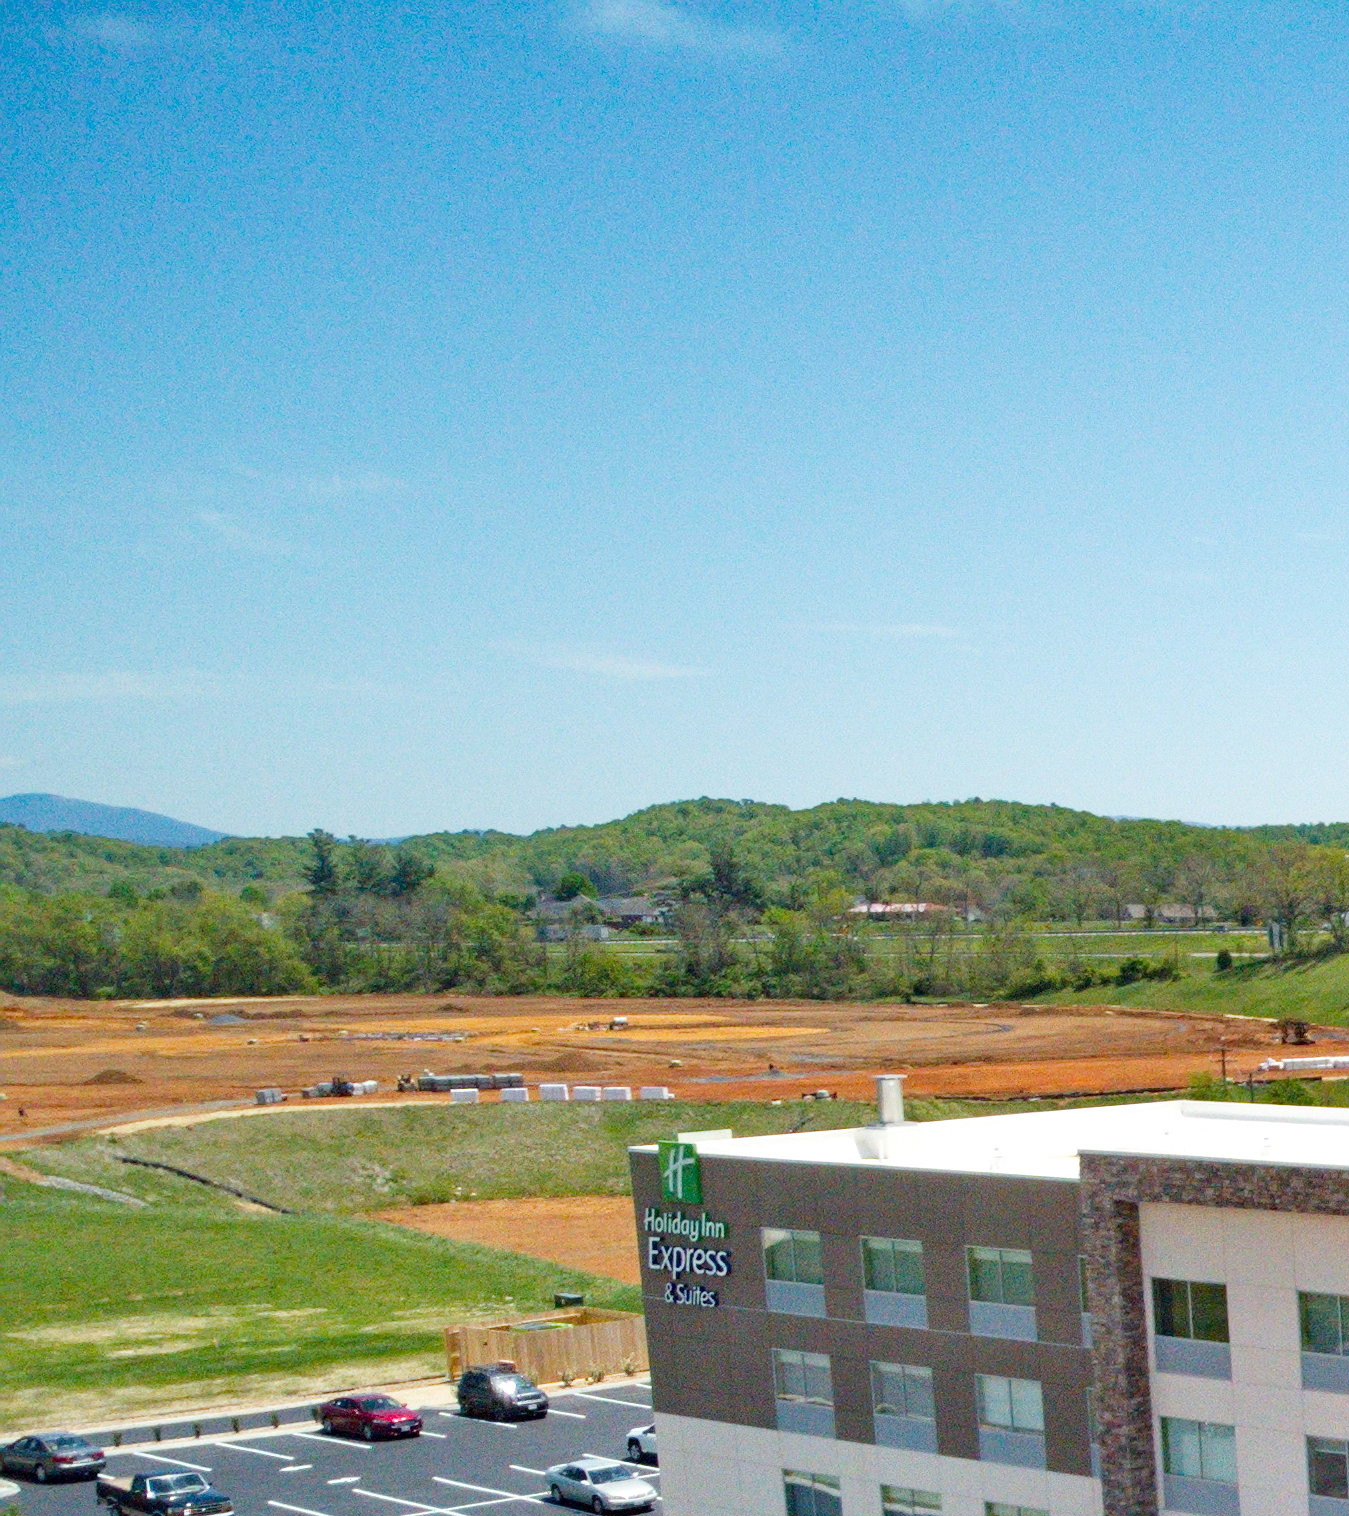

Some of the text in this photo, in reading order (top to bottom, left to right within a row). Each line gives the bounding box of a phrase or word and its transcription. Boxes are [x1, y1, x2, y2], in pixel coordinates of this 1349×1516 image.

[664, 1145, 695, 1199] H
[644, 1208, 725, 1242] Holiday Inn
[648, 1237, 729, 1280] Express
[664, 1283, 716, 1308] & Suites
